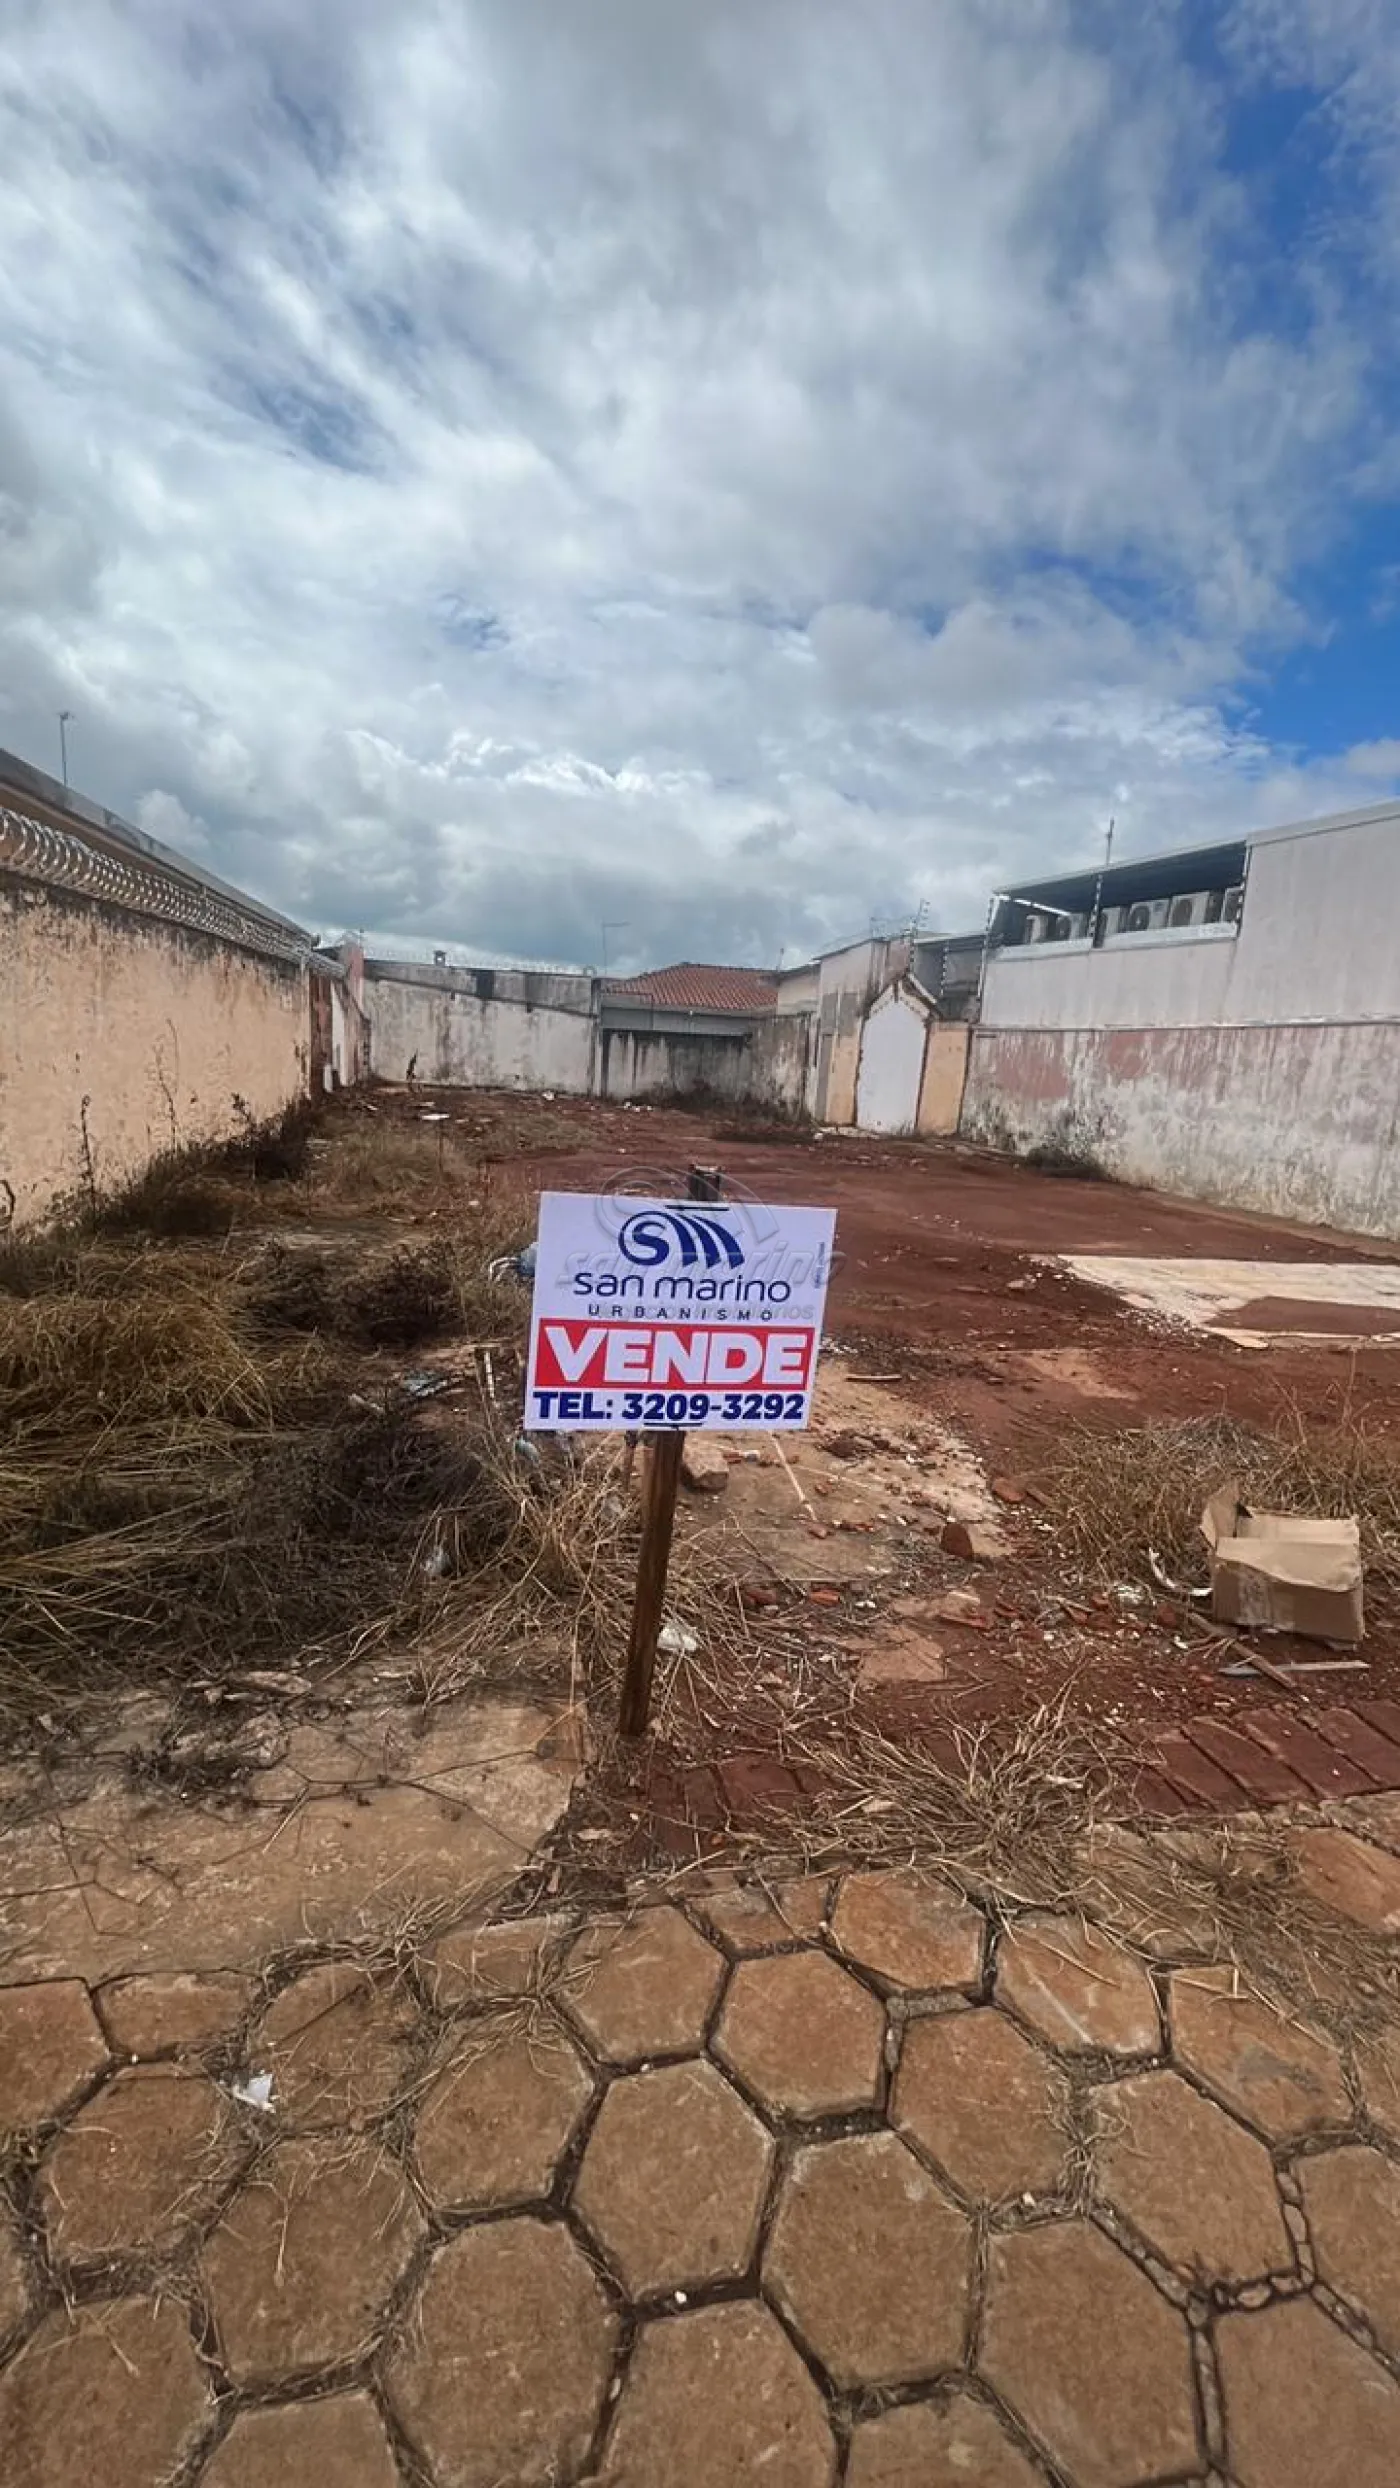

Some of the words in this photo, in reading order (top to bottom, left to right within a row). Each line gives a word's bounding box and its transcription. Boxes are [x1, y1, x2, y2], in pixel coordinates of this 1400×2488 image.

[574, 1272, 643, 1297] san
[654, 1275, 791, 1303] marino
[588, 1303, 773, 1320] URBANISMO
[545, 1326, 807, 1385] VENDE
[533, 1391, 612, 1419] TEL:
[621, 1393, 805, 1420] 3209-3292
